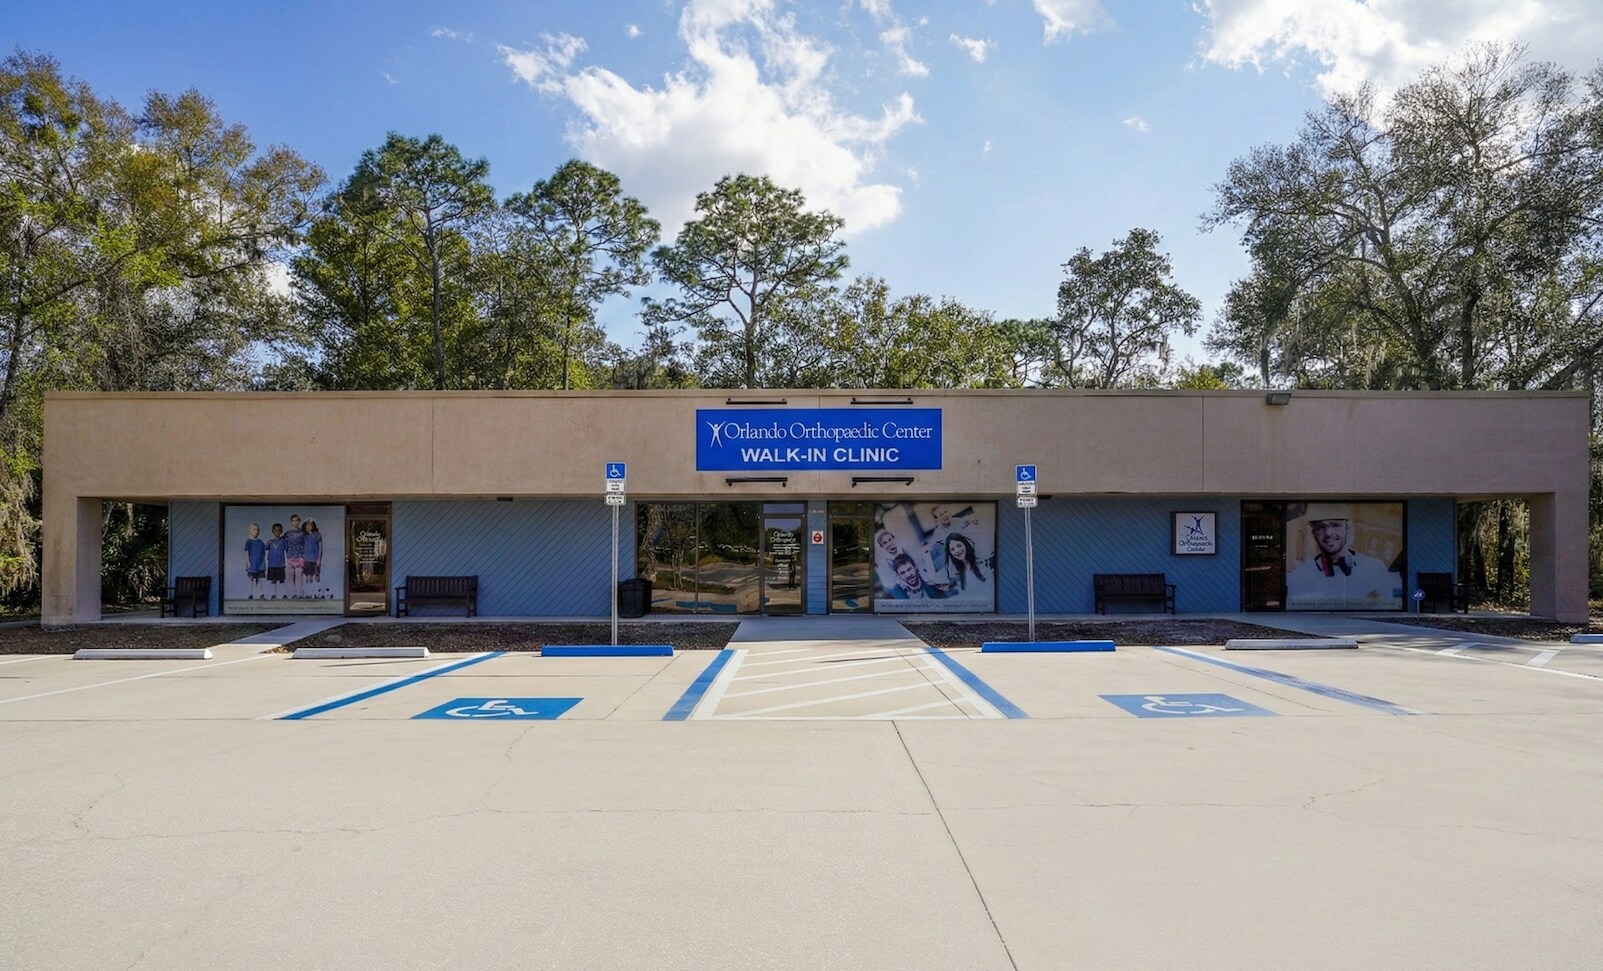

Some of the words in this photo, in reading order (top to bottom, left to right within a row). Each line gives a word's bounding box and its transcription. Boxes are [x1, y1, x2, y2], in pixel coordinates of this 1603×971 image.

[724, 422, 787, 439] Orlando
[789, 421, 879, 443] Orthopaedic
[881, 421, 933, 439] Center
[740, 447, 827, 463] WALK-IN
[833, 447, 900, 463] CLINIC
